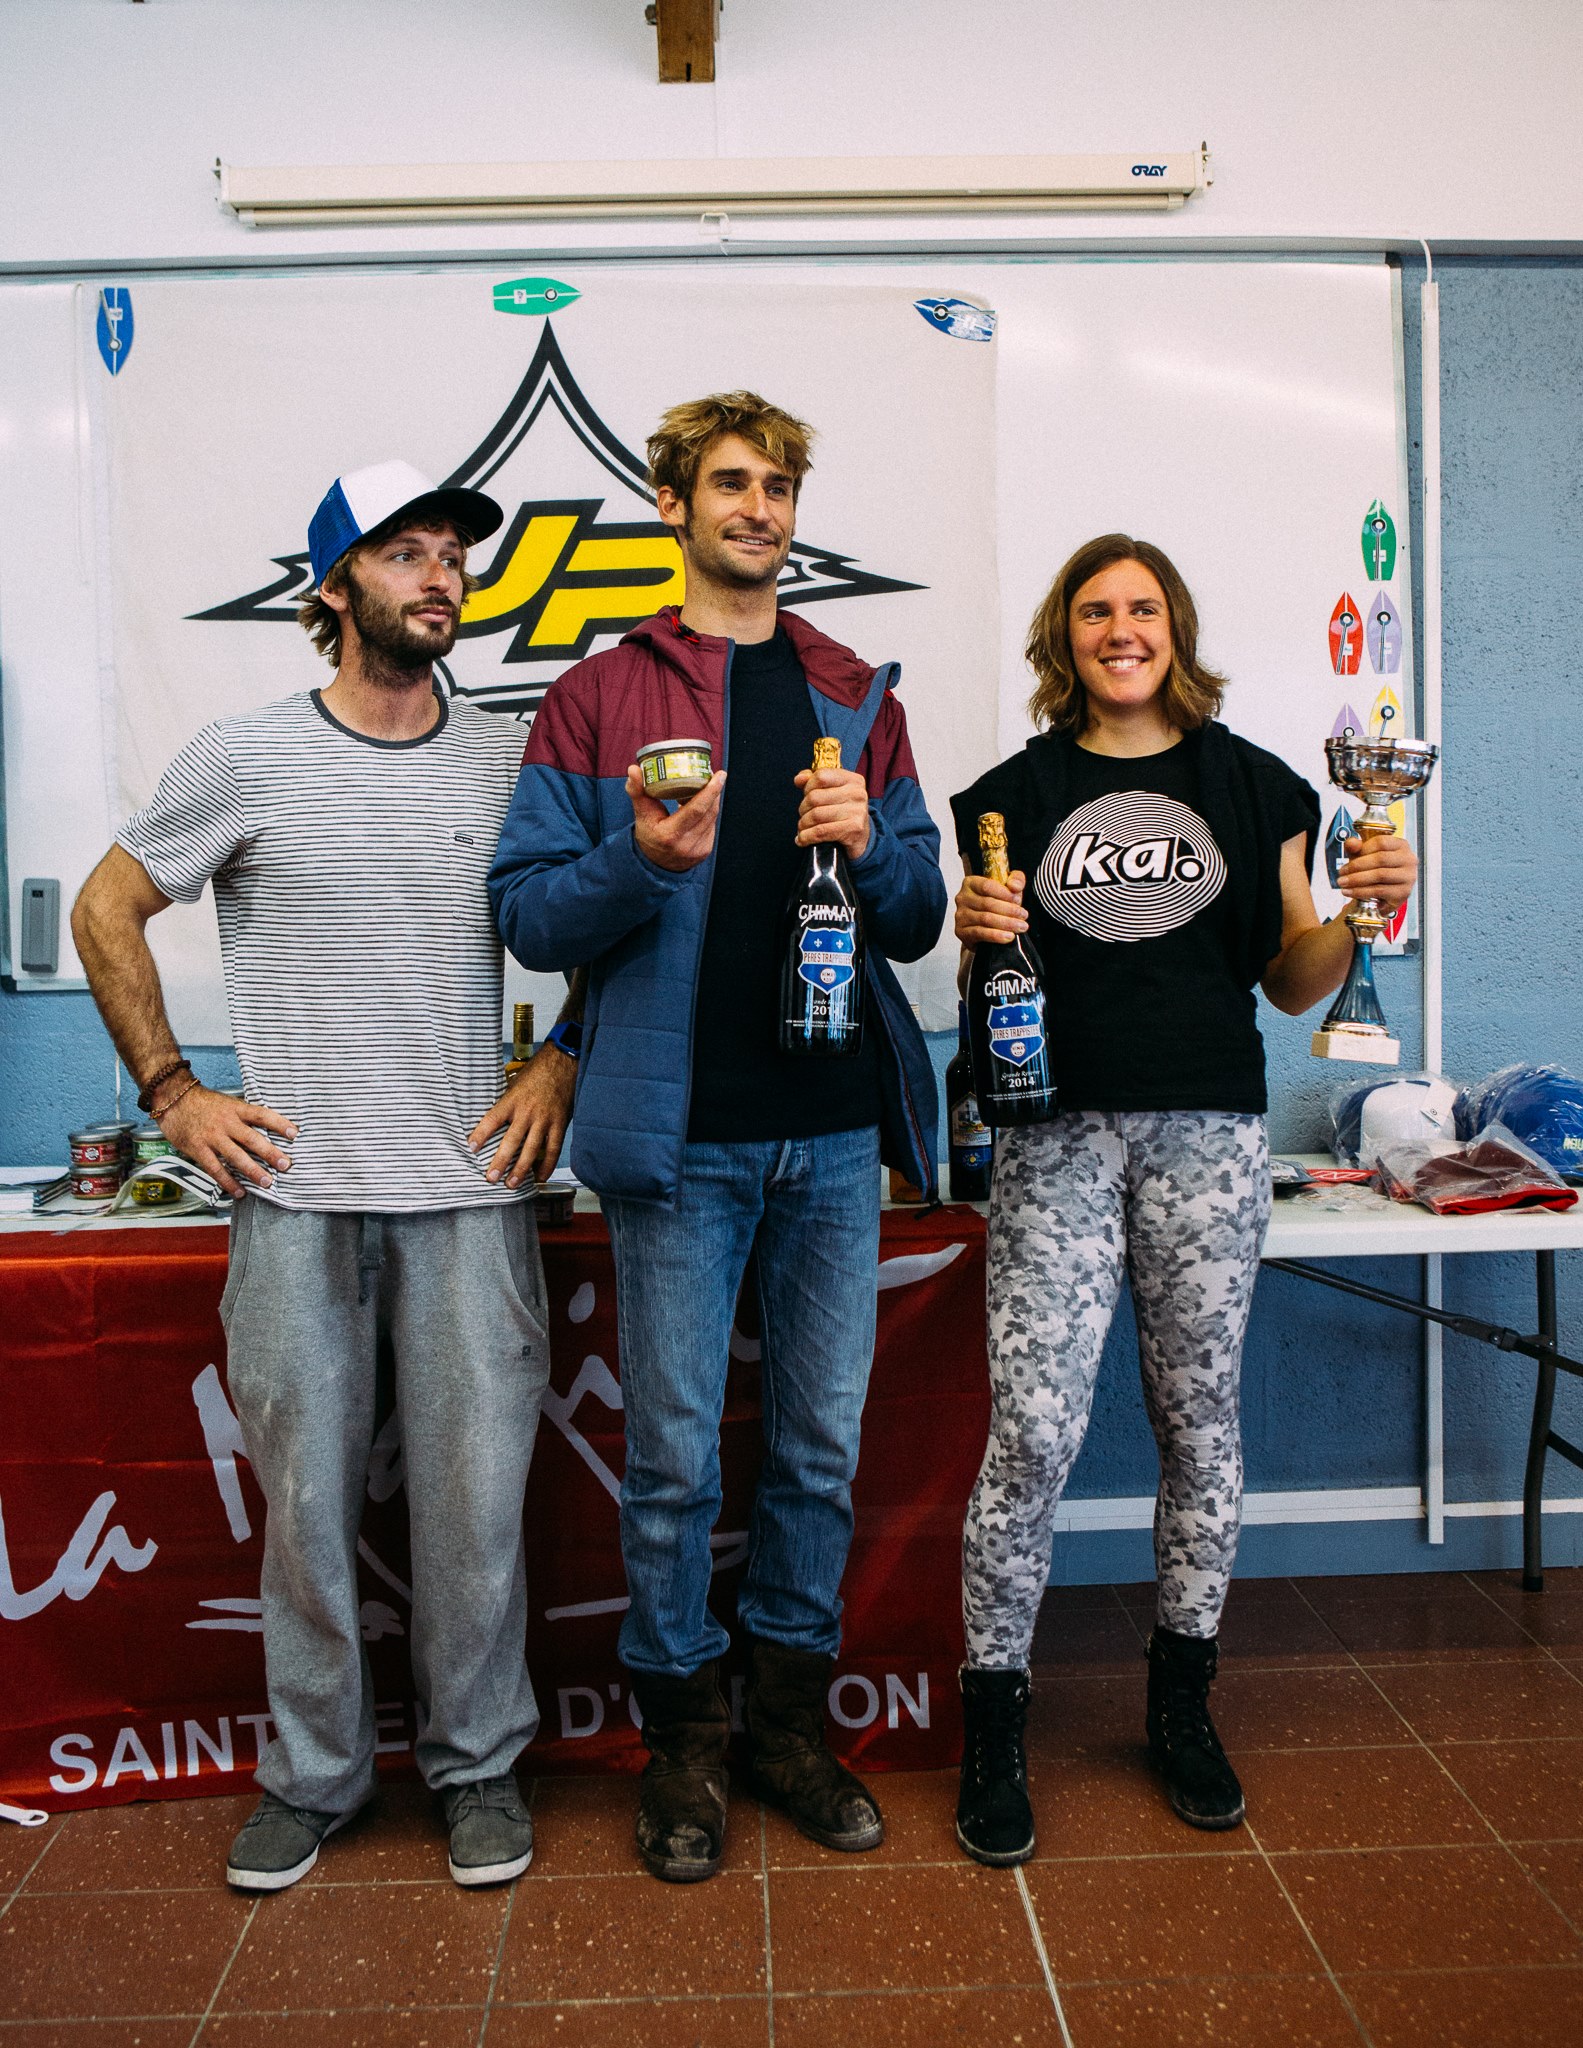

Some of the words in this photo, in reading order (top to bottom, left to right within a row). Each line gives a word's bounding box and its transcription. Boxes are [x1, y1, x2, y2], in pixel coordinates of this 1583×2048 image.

[1131, 165, 1168, 176] ORAY
[457, 500, 687, 662] JP
[798, 904, 856, 922] CHIMAY
[984, 976, 1037, 997] CHIMAY
[1007, 1076, 1036, 1088] 2014
